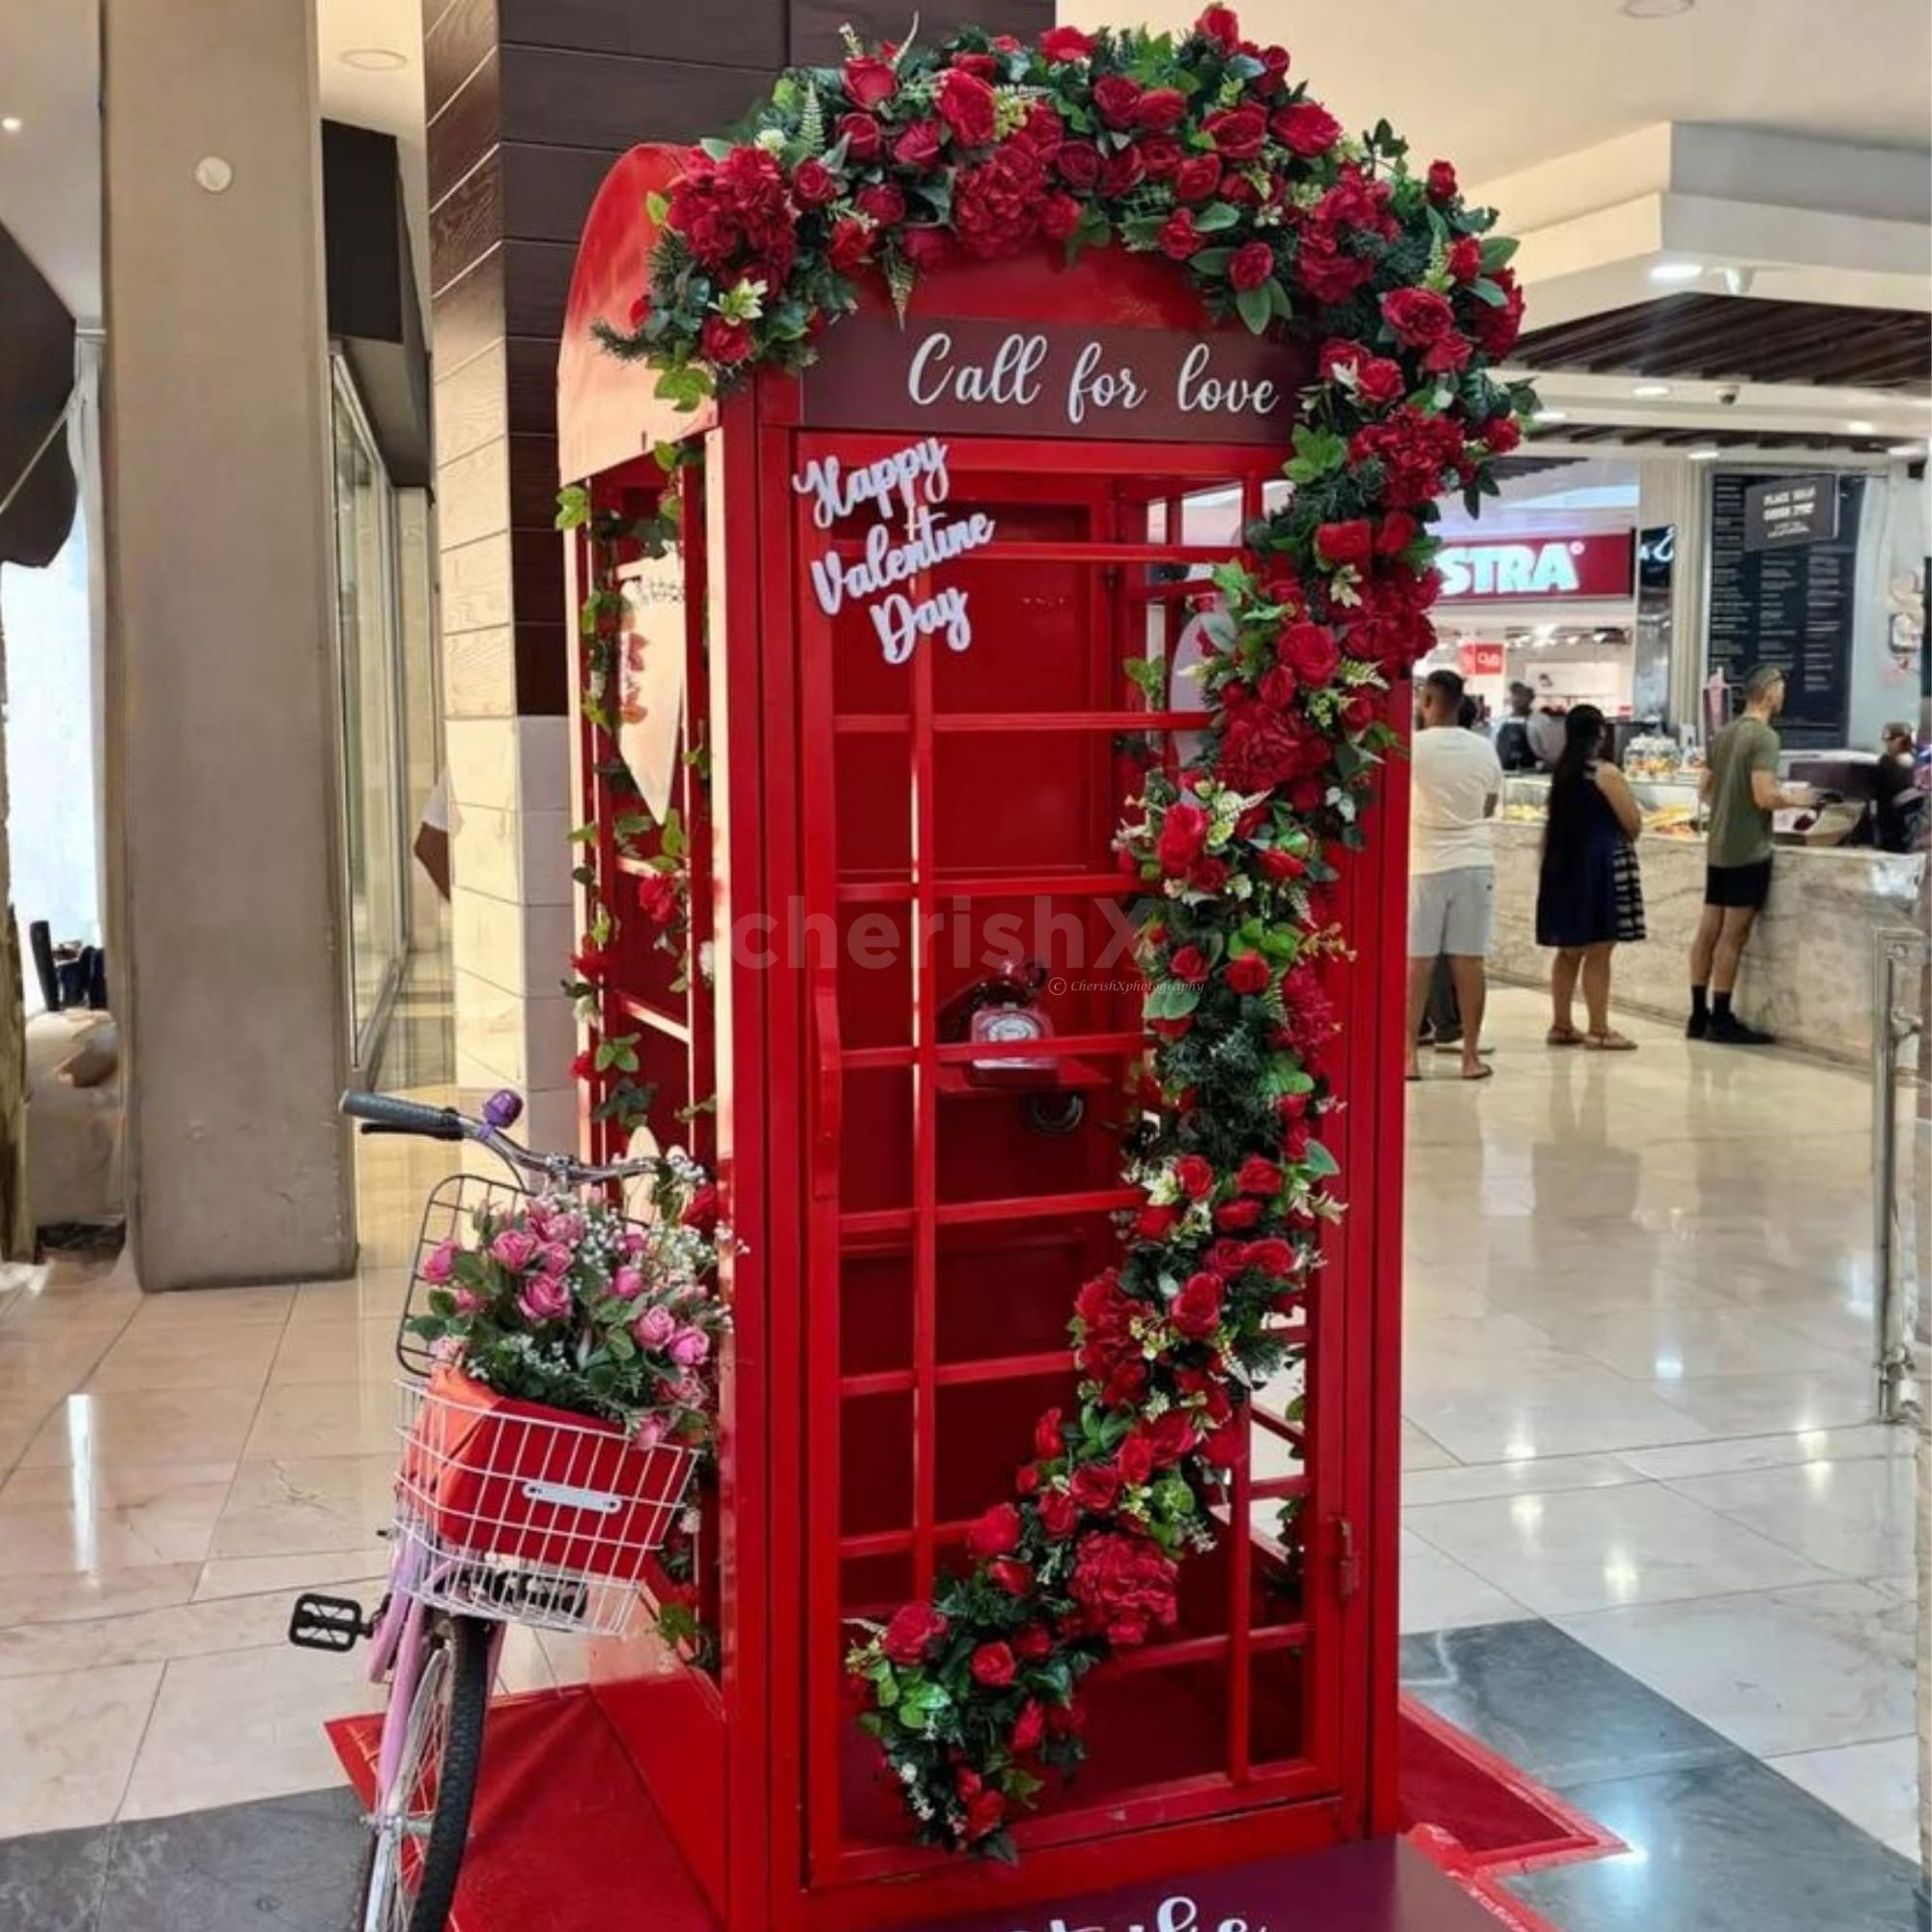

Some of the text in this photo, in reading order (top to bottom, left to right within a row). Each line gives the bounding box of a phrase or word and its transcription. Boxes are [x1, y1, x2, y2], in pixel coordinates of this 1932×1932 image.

[908, 331, 1280, 424] Call for love
[792, 437, 950, 528] Happy
[810, 505, 996, 616] Valentine
[869, 587, 972, 665] Day
